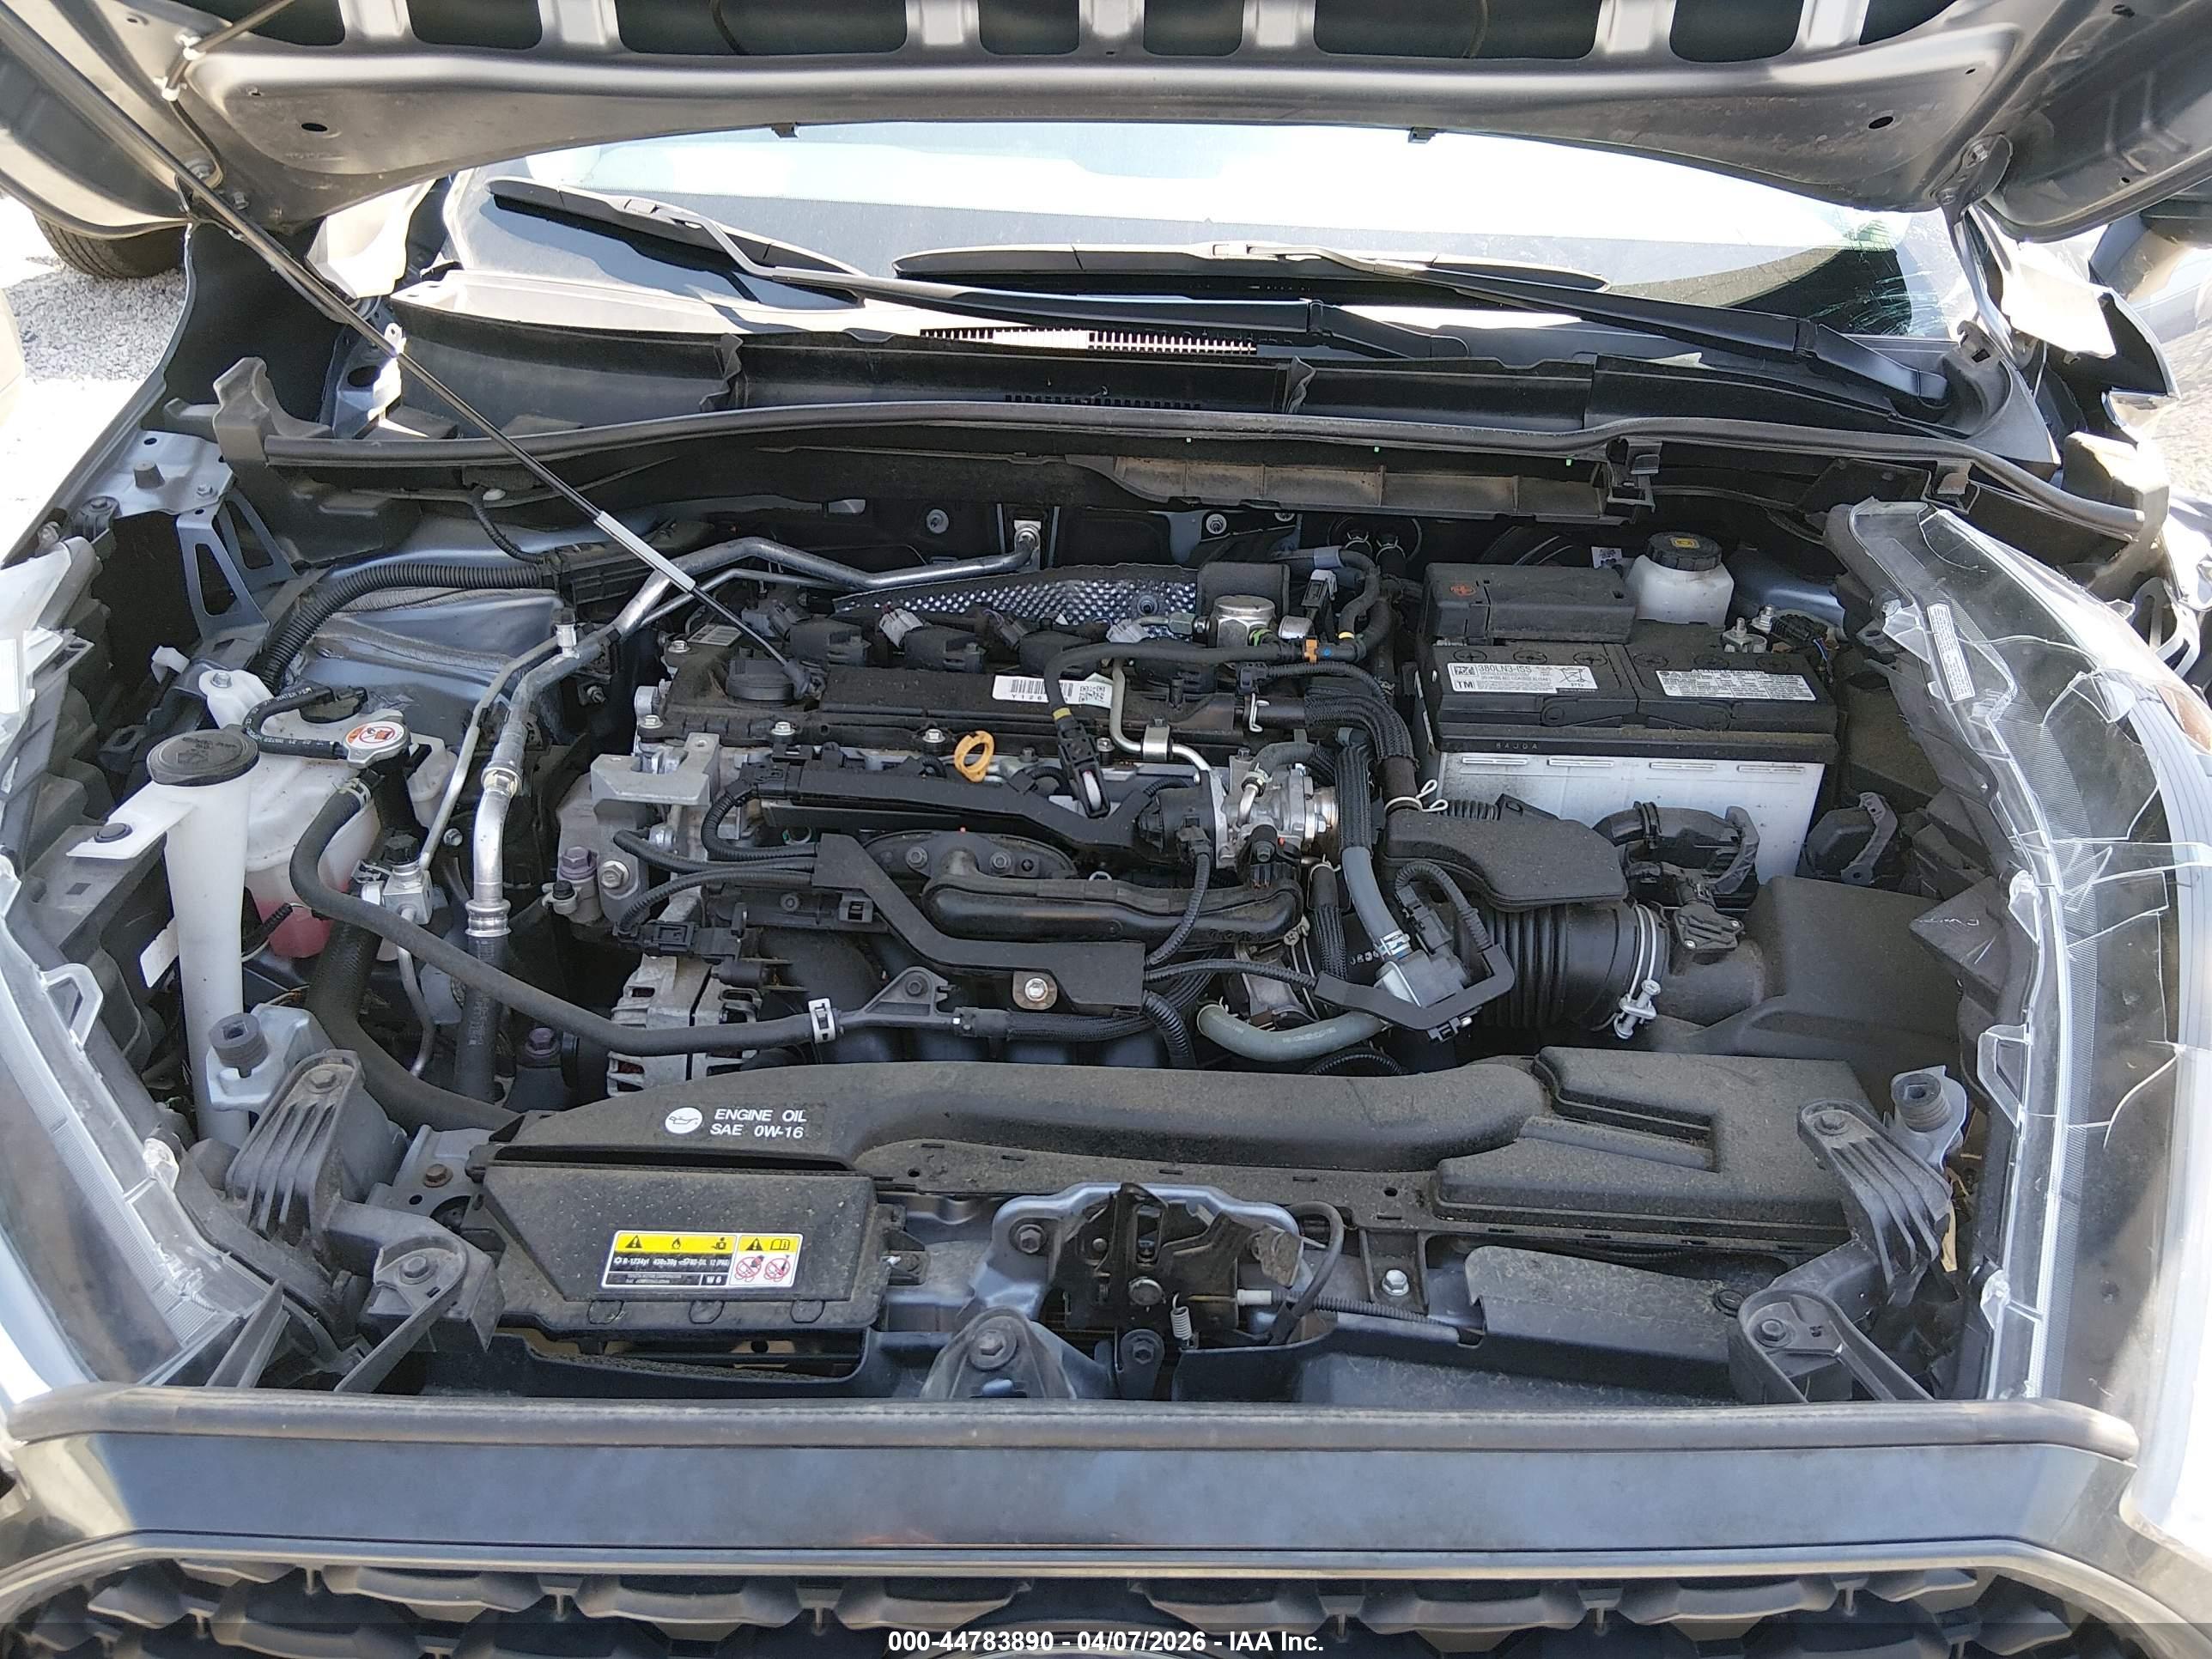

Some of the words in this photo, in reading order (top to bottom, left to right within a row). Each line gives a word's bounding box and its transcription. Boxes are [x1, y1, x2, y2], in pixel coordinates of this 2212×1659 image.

[714, 1108, 773, 1121] ENGINE
[781, 1109, 807, 1122] OIL
[710, 1123, 744, 1135] SAE
[754, 1125, 804, 1139] 0W-16
